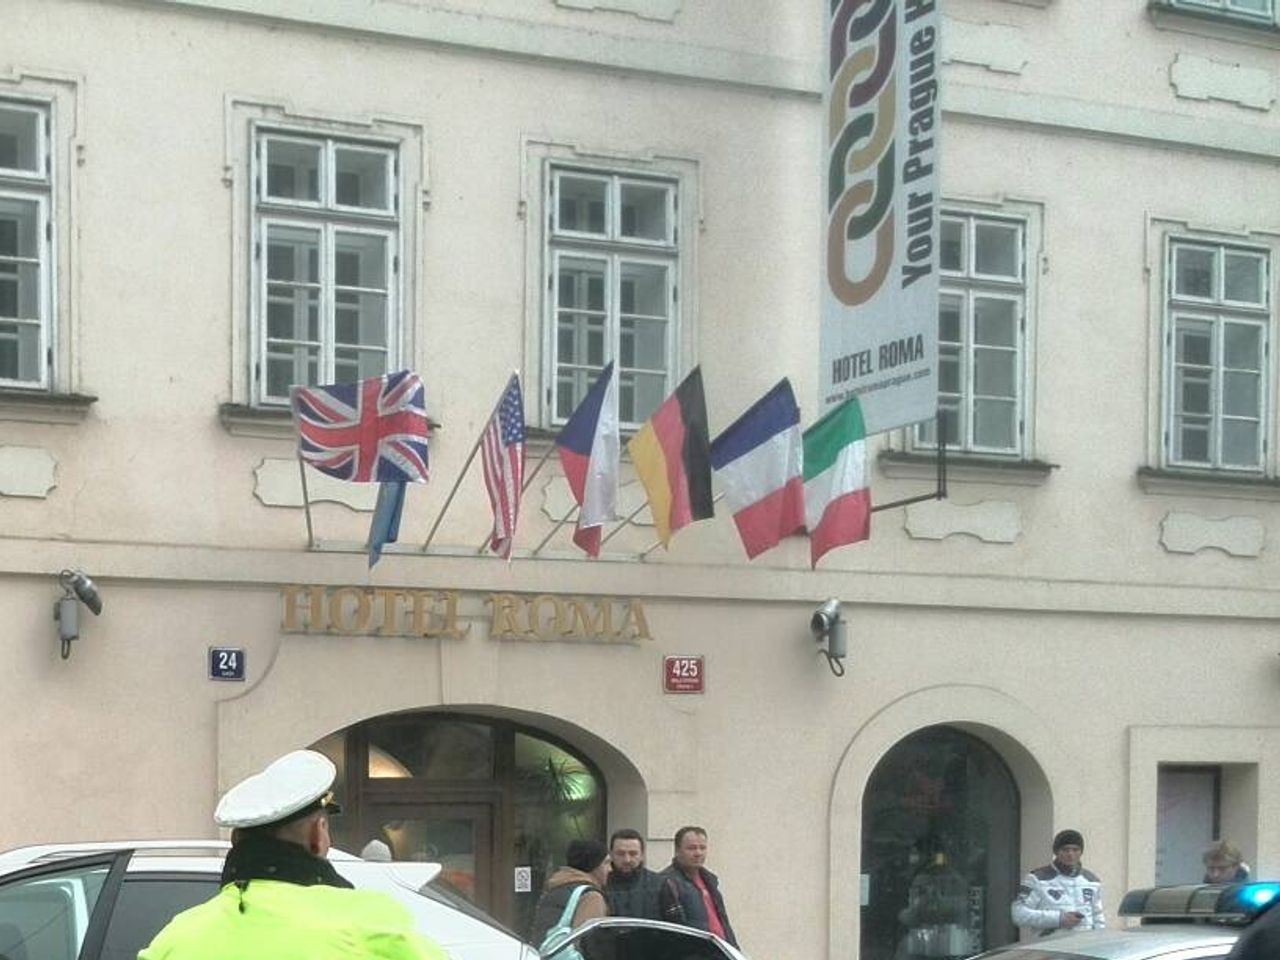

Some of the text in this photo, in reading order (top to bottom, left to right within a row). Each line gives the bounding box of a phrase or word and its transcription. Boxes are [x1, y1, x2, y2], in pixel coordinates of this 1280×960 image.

[903, 25, 938, 184] Prague
[902, 192, 933, 289] Your
[832, 333, 924, 385] HOTEL ROMA
[279, 584, 654, 642] HOTEL ROMA
[219, 652, 237, 670] 24
[672, 660, 698, 677] 425
